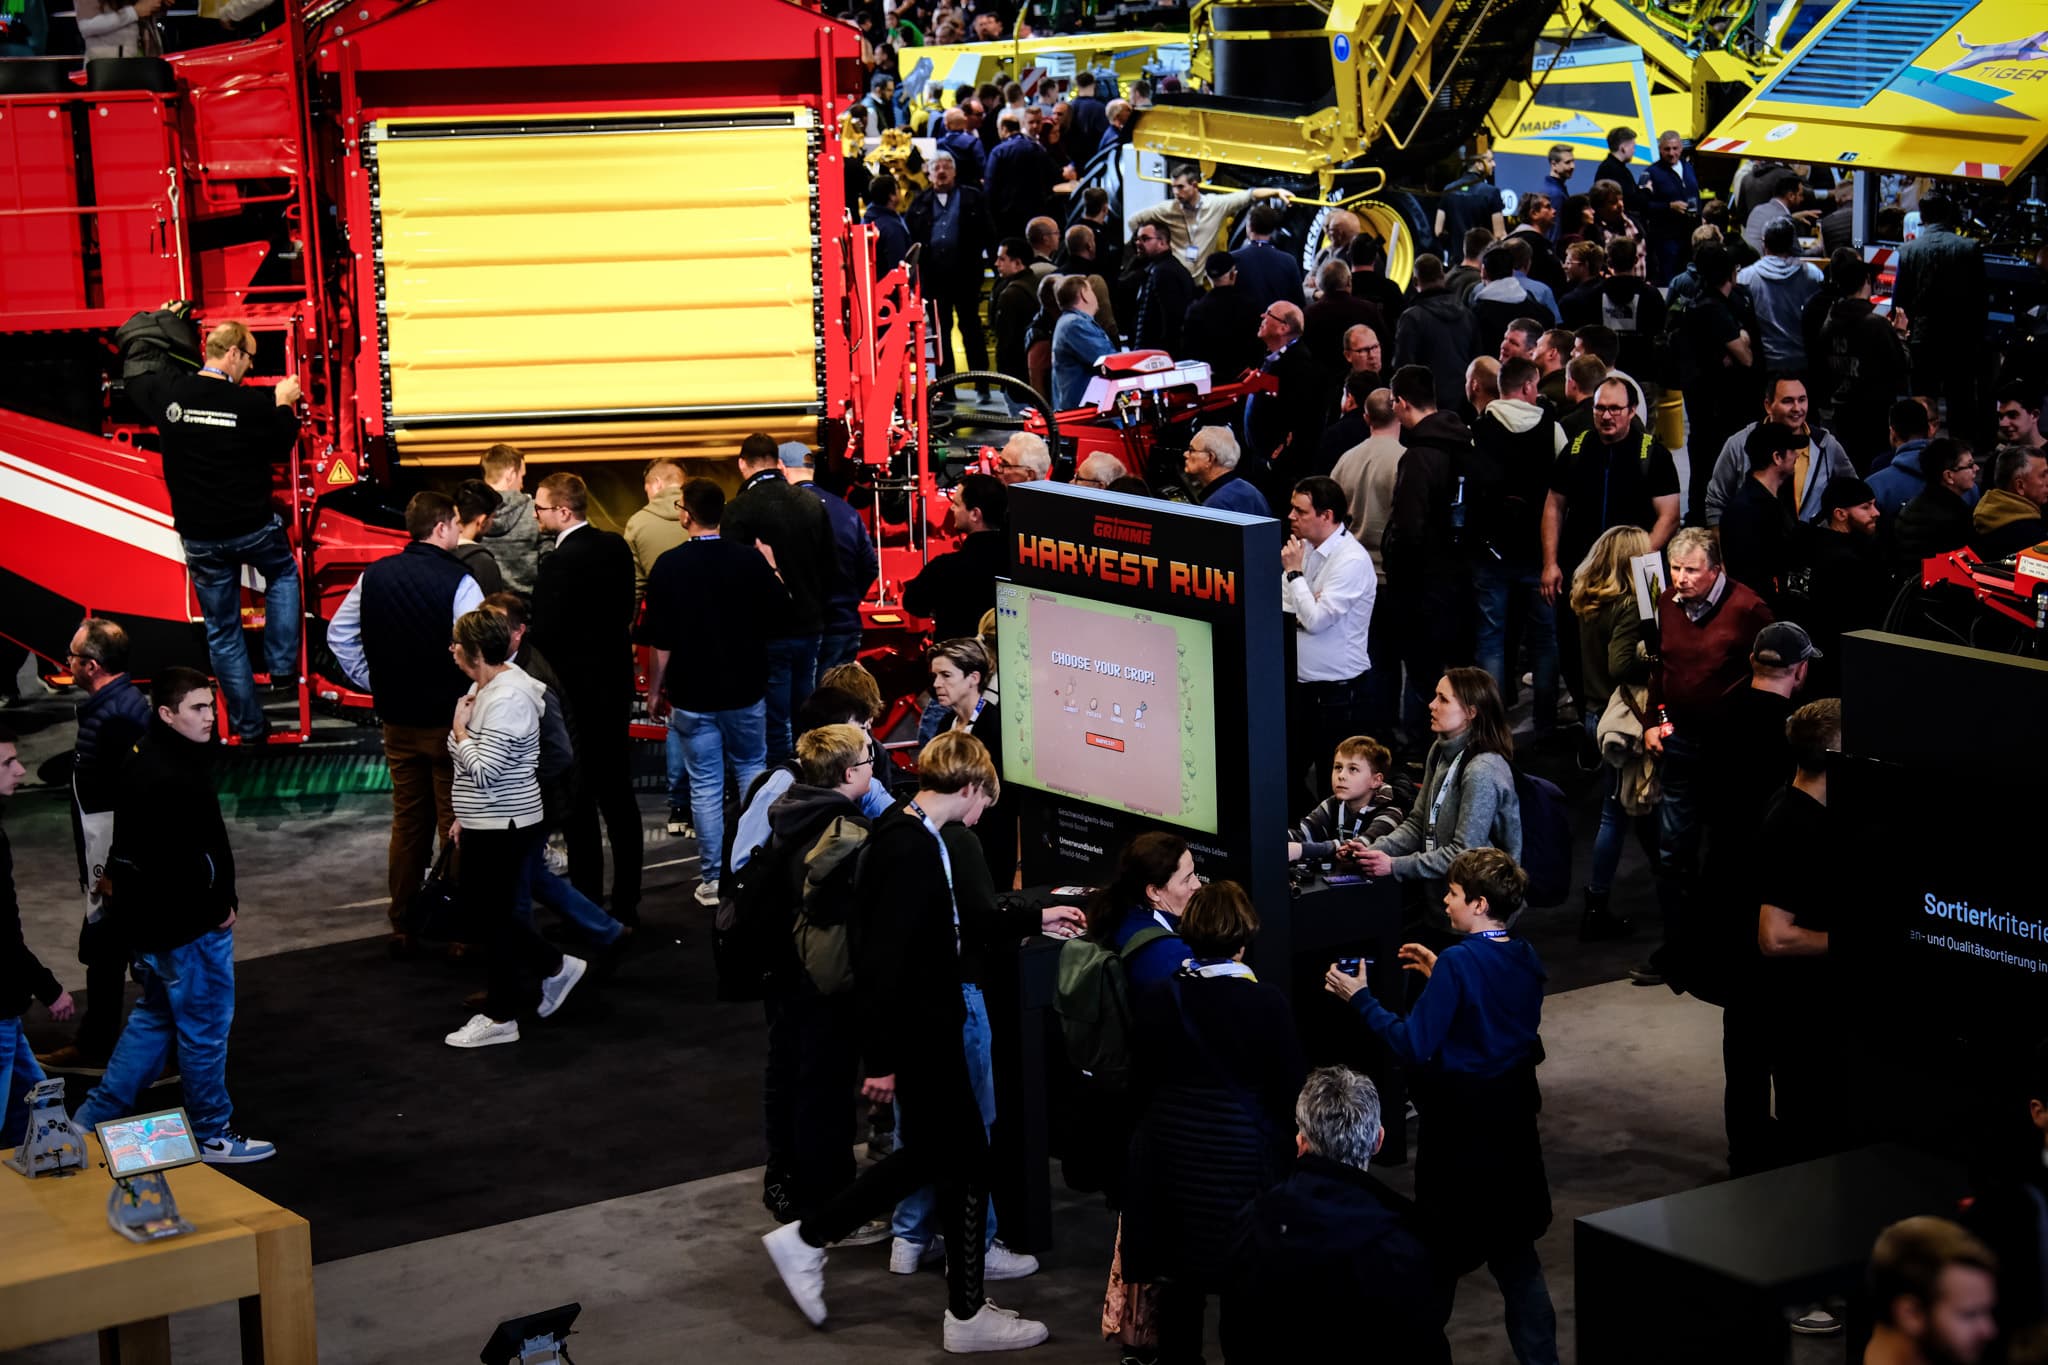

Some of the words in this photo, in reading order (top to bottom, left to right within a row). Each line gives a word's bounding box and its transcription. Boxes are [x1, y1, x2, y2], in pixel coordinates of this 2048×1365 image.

[1536, 56, 1576, 68] ROPA
[1977, 66, 2048, 81] TIGER
[1520, 120, 1561, 133] MAUS
[1093, 516, 1152, 545] GRIMME
[1018, 533, 1159, 589] HARVEST
[1170, 560, 1235, 605] RUN
[1051, 651, 1092, 672] CHOOSE
[1094, 659, 1122, 678] YOUR
[1124, 666, 1156, 686] CROP!
[1927, 934, 1946, 947] und
[1947, 937, 2037, 973] Qualitätsortierung
